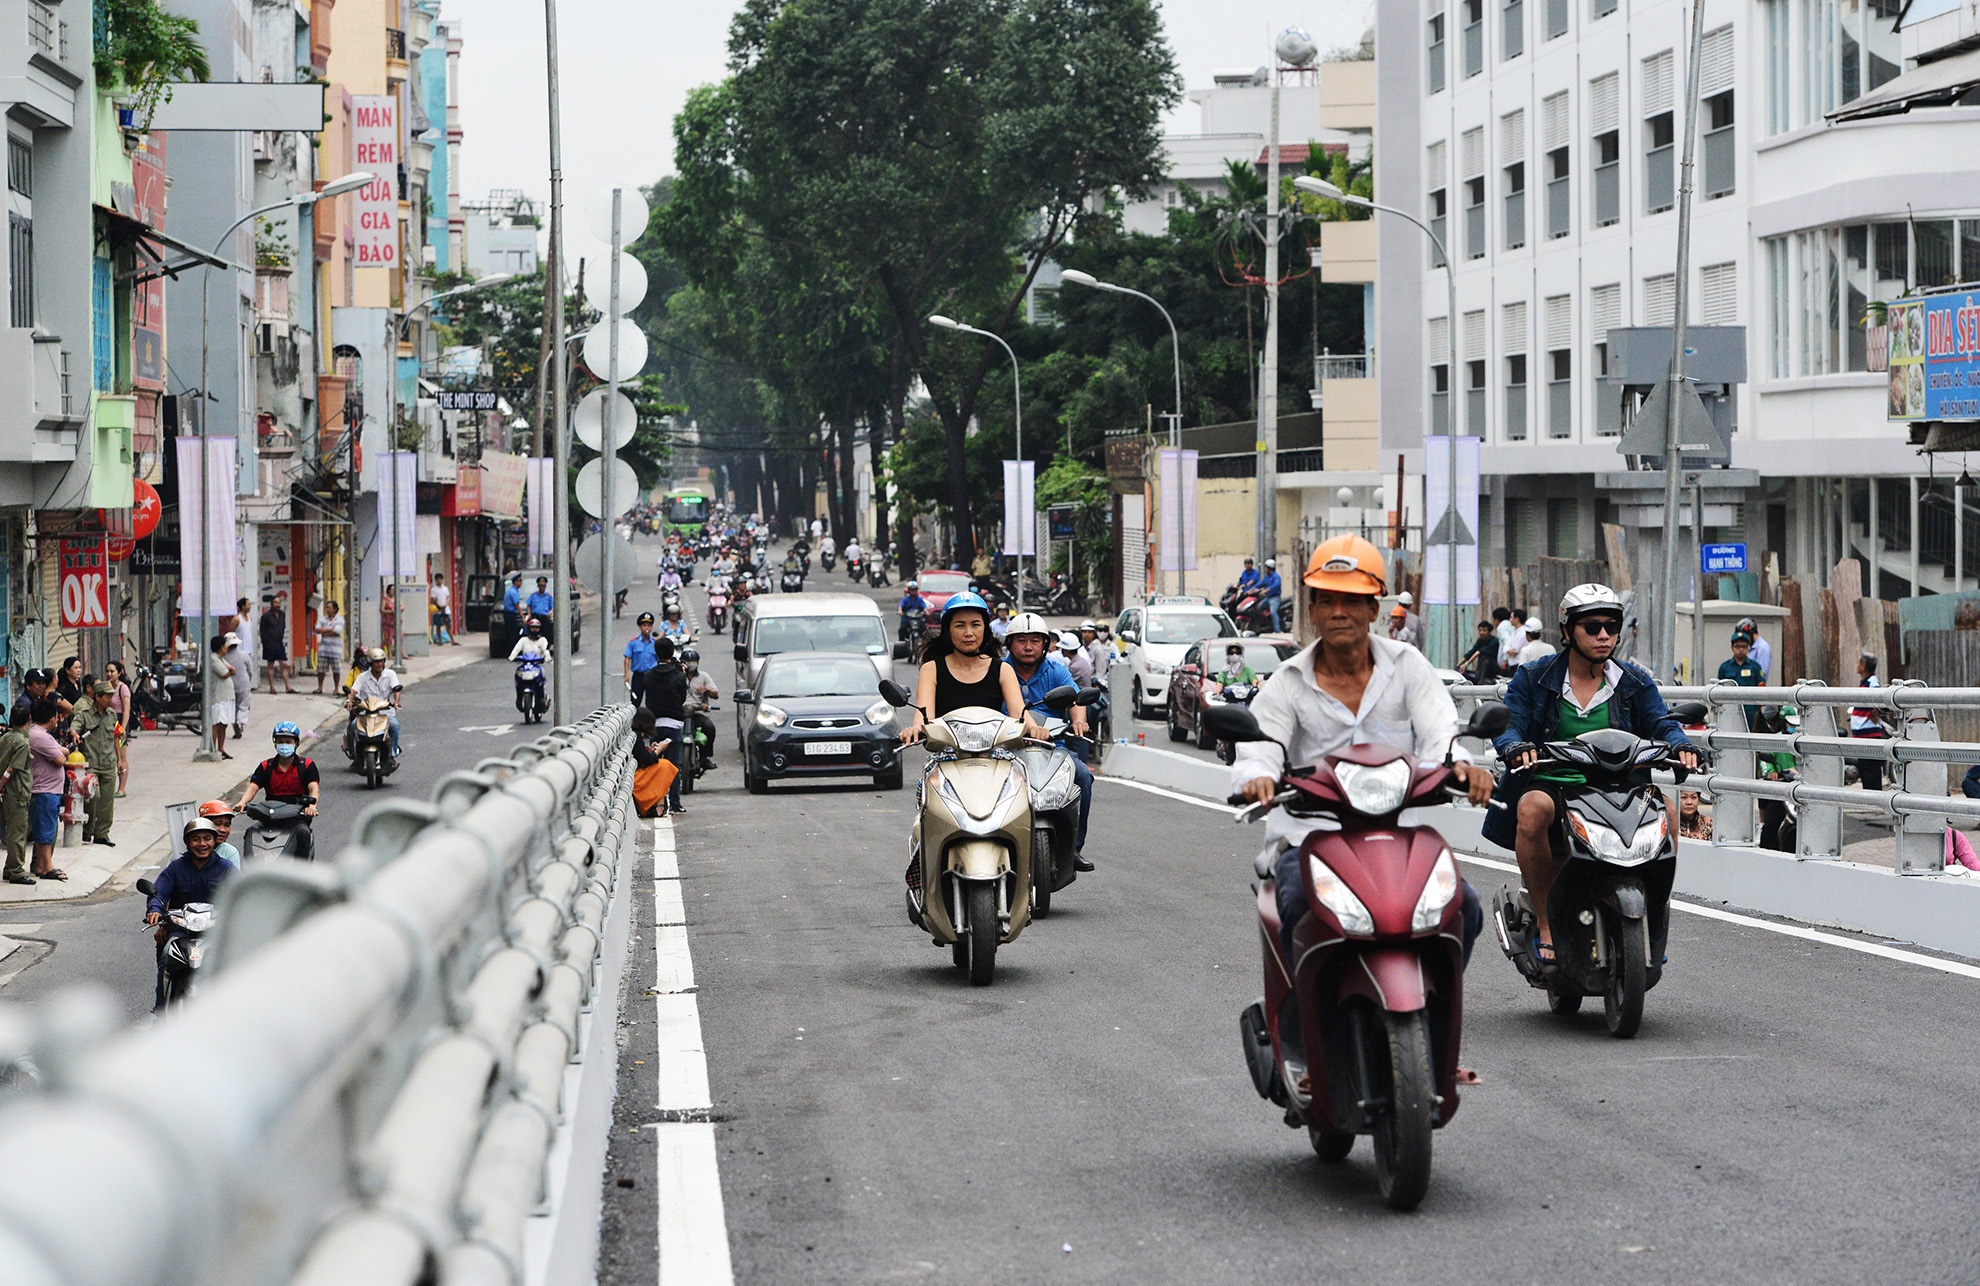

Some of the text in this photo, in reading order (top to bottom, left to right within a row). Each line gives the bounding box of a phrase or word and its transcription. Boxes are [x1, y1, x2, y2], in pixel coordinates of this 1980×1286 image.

[357, 101, 392, 127] MÀN
[357, 137, 392, 163] RÈM
[360, 212, 391, 229] GIA
[358, 236, 394, 262] BẢO
[1928, 309, 1954, 356] BIA
[439, 392, 496, 409] THE MINT SHOP
[63, 550, 103, 568] YÊU
[62, 573, 106, 625] OK
